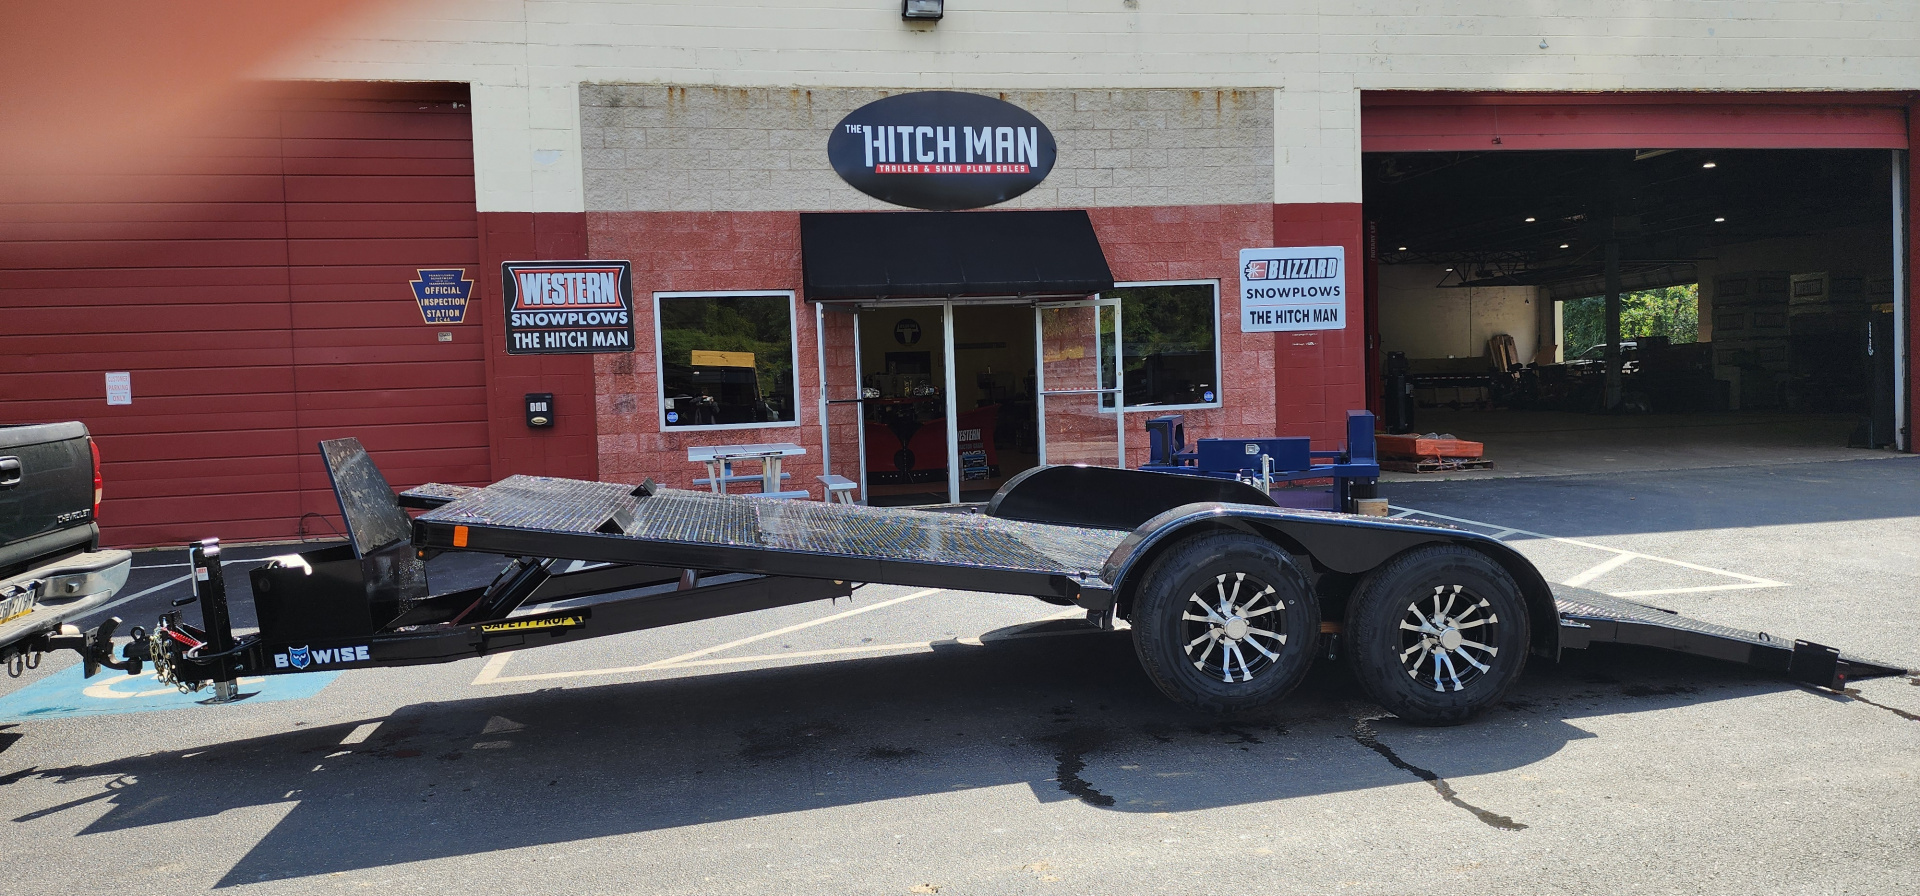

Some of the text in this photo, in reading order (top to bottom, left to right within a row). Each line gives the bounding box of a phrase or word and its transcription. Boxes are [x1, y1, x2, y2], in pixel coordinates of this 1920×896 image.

[845, 124, 1038, 168] THE HITCH MAN
[879, 165, 1026, 173] TRAILER & SNOW PLOW SALES
[1268, 258, 1337, 279] BLIZZARD
[424, 286, 461, 294] OFFICIAL
[520, 272, 615, 305] WESTERN
[1246, 286, 1340, 299] SNOWPLOWS
[420, 298, 466, 306] INSPECTION
[426, 309, 460, 318] STATION
[511, 312, 629, 326] SNOWPLOWS
[1250, 308, 1338, 325] THE HITCH MAN
[513, 330, 629, 349] THE HITCH MAN
[57, 508, 91, 524] CHEVROLET
